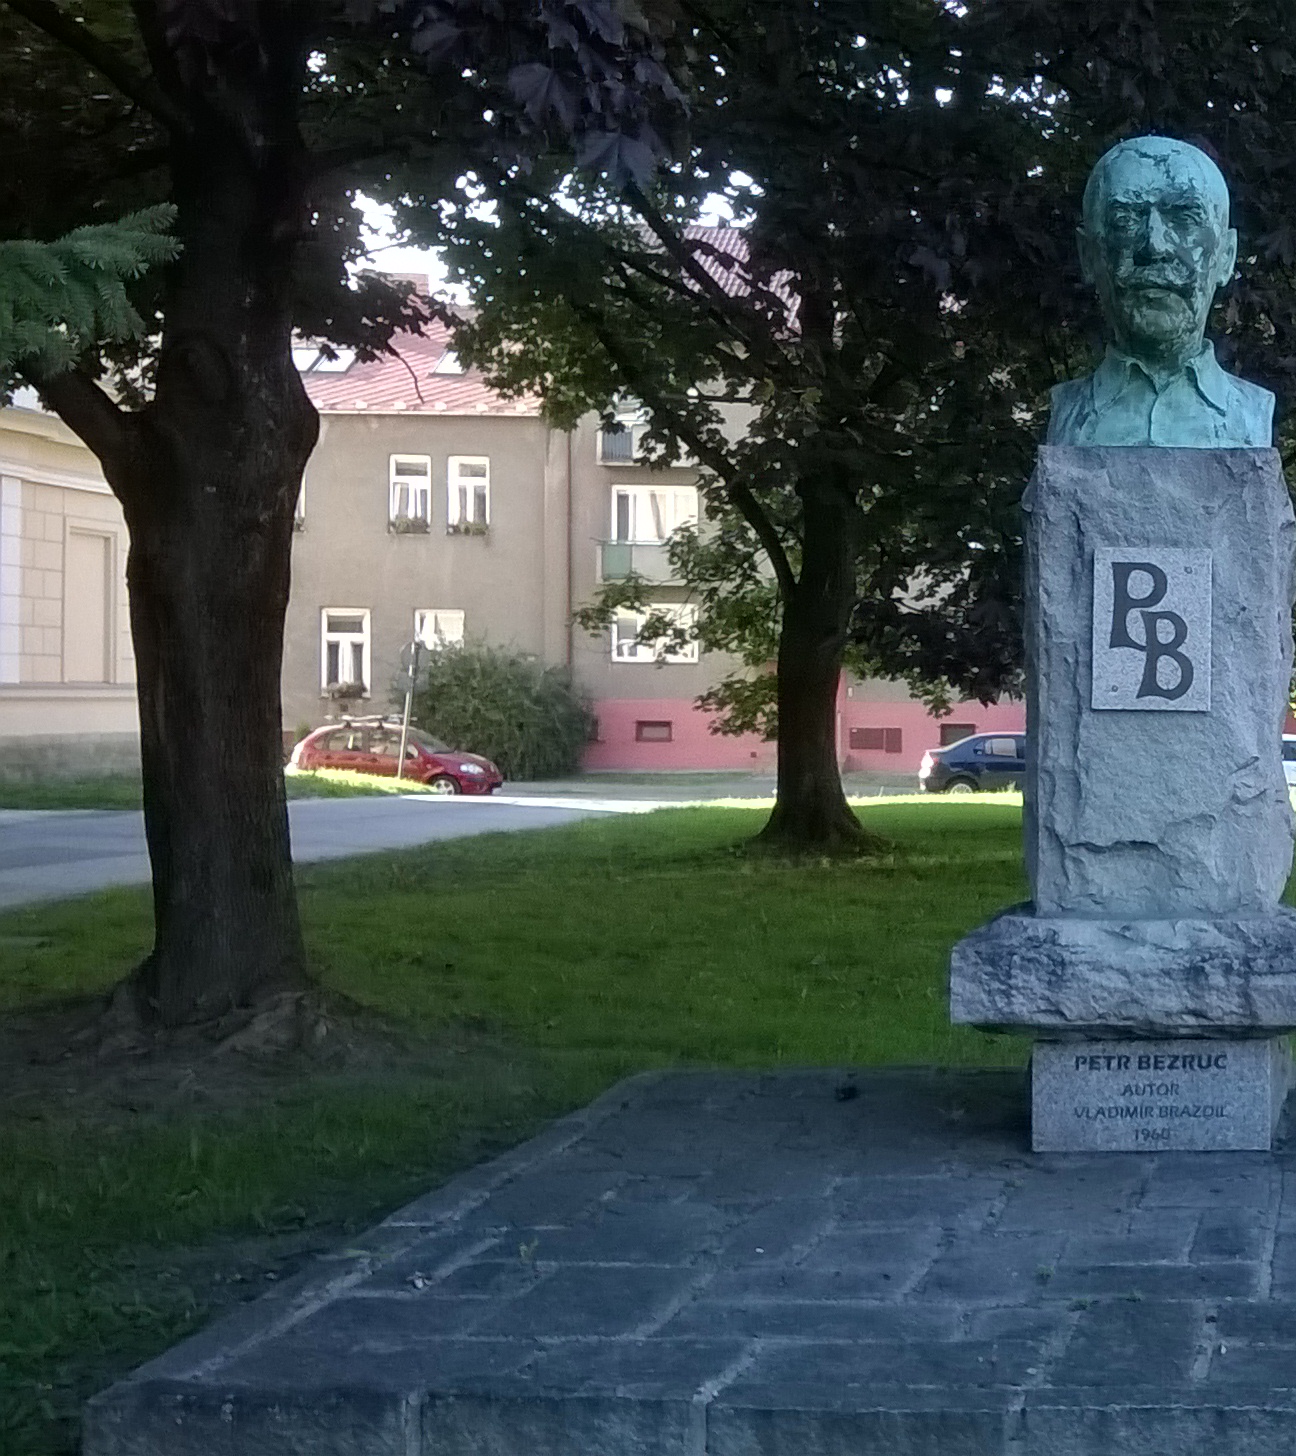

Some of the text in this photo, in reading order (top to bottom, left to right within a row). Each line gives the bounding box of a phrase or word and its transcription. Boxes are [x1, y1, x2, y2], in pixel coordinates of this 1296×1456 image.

[1075, 1054, 1131, 1071] PETR
[1120, 1082, 1180, 1097] AUTOR
[1135, 1127, 1171, 1141] 1960
